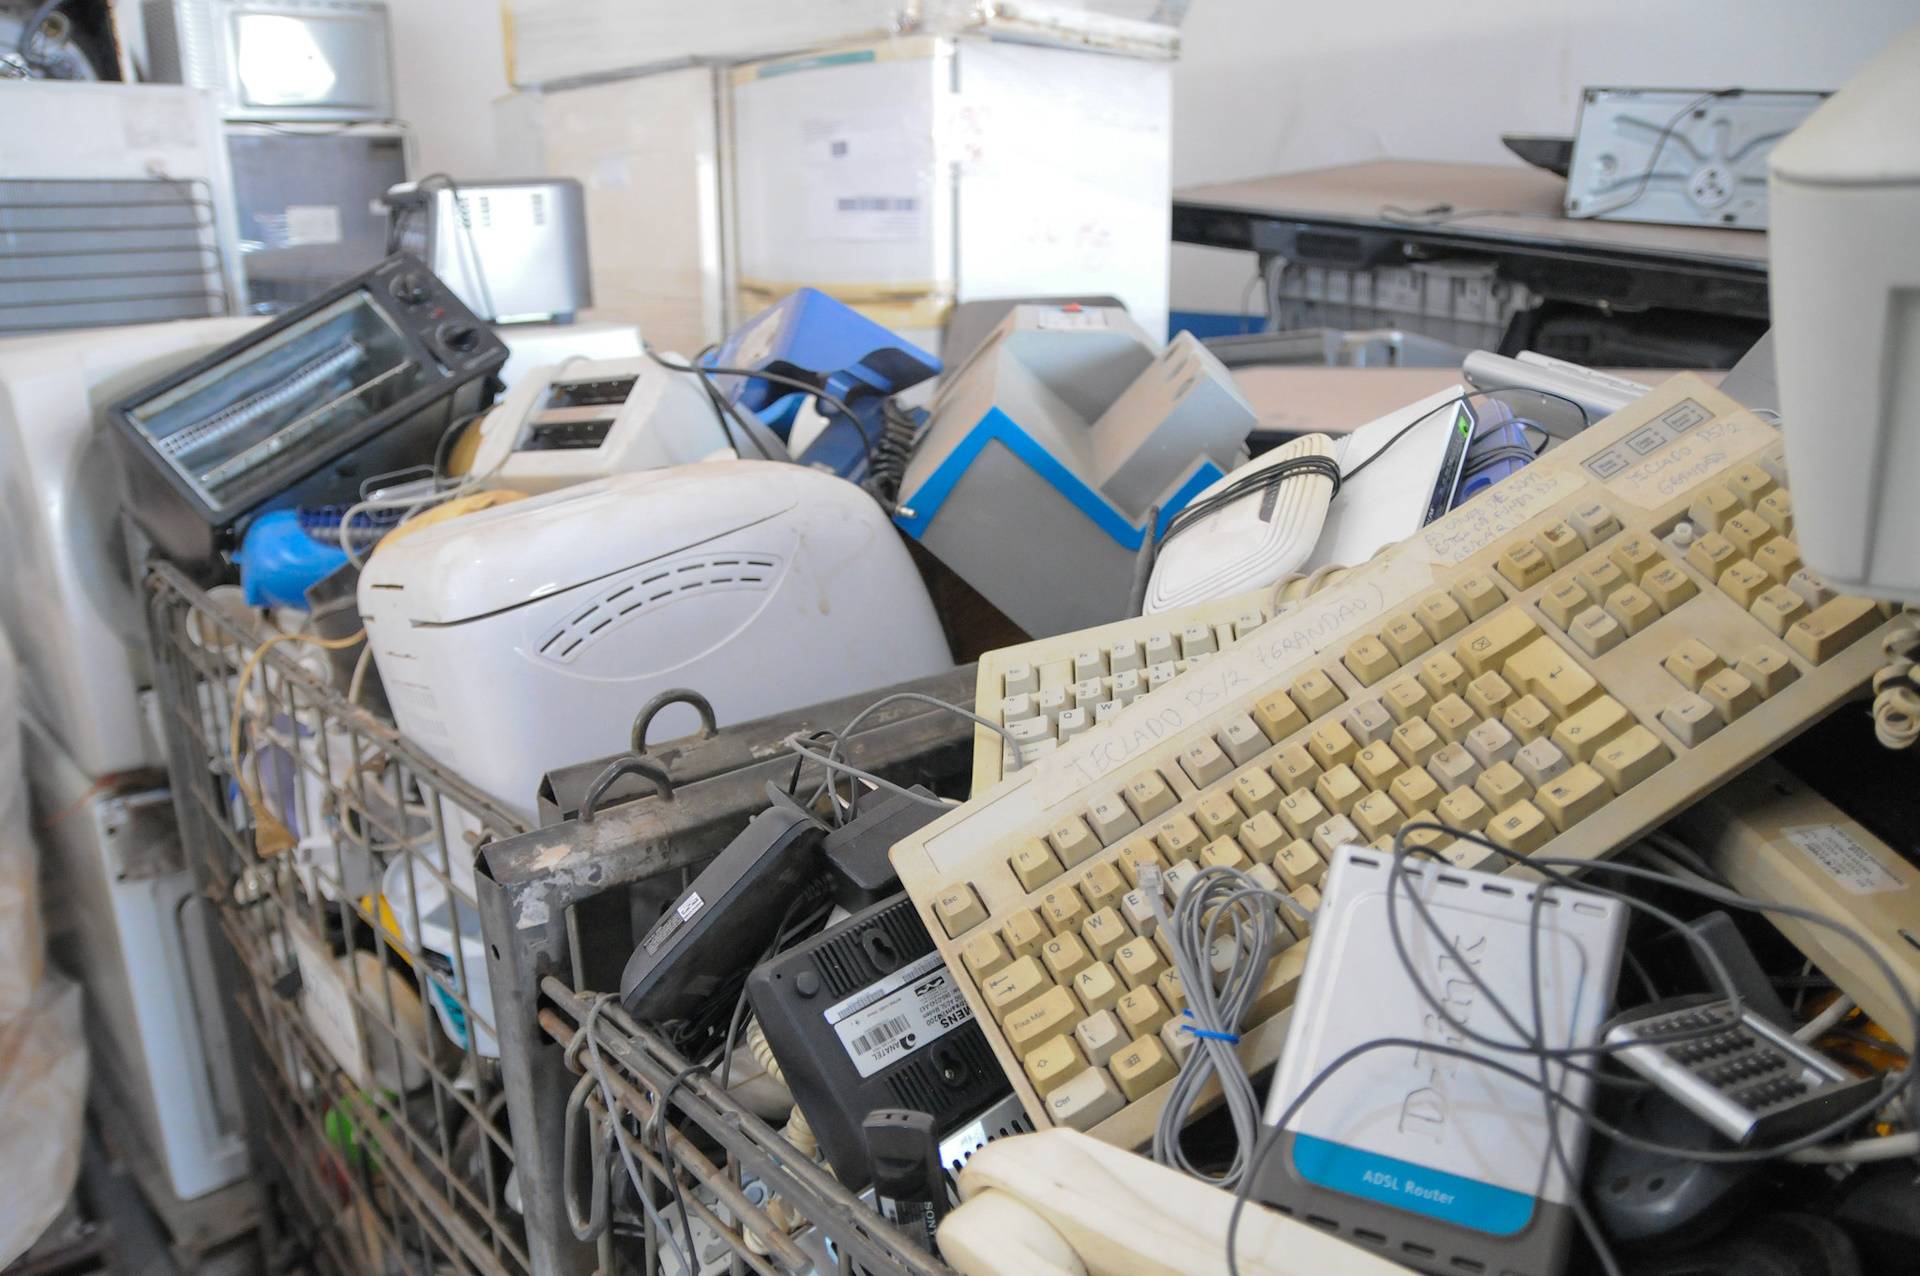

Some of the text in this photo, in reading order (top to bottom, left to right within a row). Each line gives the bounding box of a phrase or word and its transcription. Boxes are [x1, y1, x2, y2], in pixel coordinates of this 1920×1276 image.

[1101, 703, 1113, 711] W
[1063, 711, 1073, 719] Q
[1399, 727, 1409, 737] P
[1063, 707, 1184, 783] TECLADO
[1362, 751, 1374, 761] O
[1399, 779, 1410, 788] L
[1285, 799, 1297, 809] U
[1359, 802, 1372, 812] K
[1095, 805, 1108, 815] F3
[1245, 821, 1257, 832] Y
[1056, 828, 1070, 839] F2
[1018, 851, 1031, 862] F1
[1206, 846, 1216, 856] T
[1281, 849, 1294, 860] H
[1167, 871, 1180, 881] R
[1128, 895, 1139, 906] E
[1088, 917, 1103, 930] W
[1048, 942, 1061, 953] Q
[1121, 948, 1134, 959] S
[1081, 974, 1092, 985] A
[1166, 971, 1178, 982] X
[1124, 997, 1136, 1009] Z
[939, 1005, 972, 1028] MENS
[871, 1041, 901, 1061] ANATEL
[1054, 1095, 1071, 1109] Ctrl
[1362, 1168, 1456, 1205] ADSL Router
[924, 1201, 937, 1236] SONY
